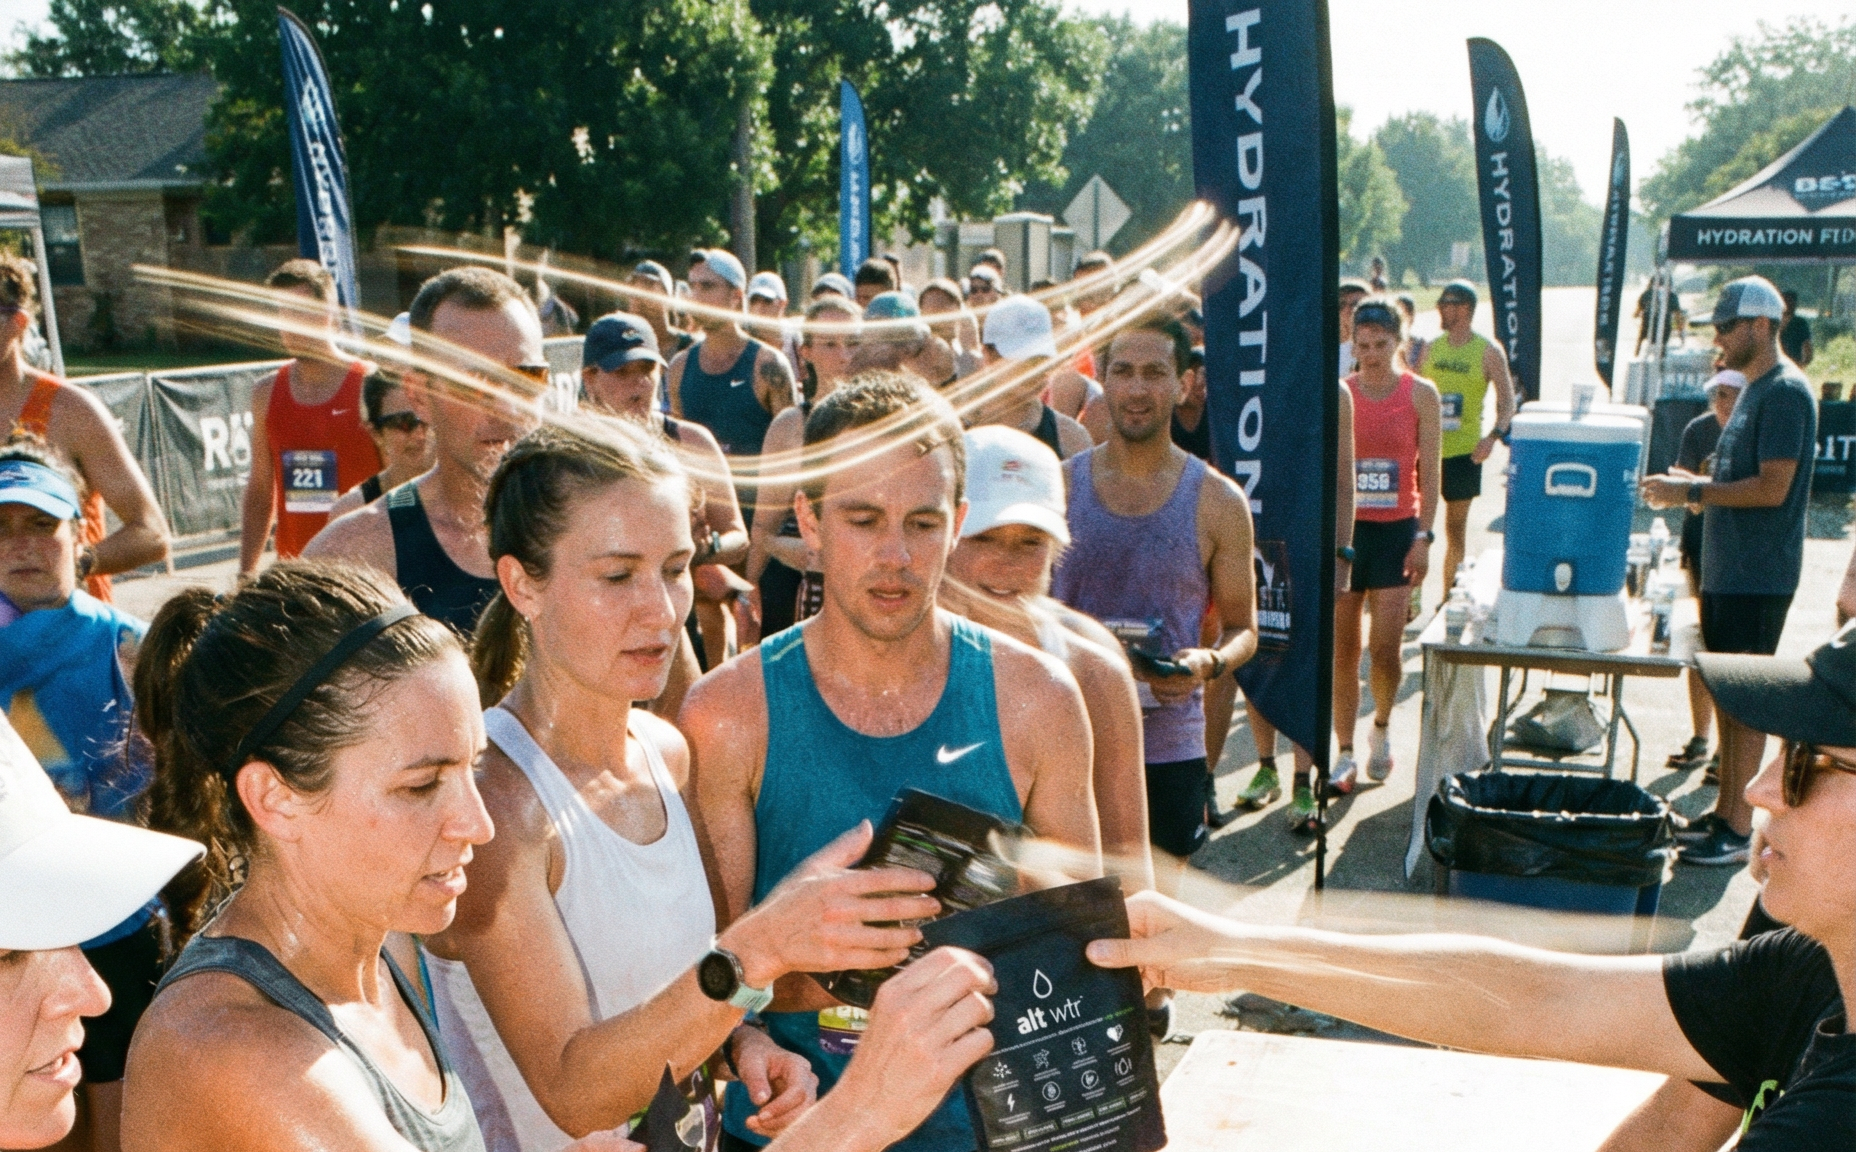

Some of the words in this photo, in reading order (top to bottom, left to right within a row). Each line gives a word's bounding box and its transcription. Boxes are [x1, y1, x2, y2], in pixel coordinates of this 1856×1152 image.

[1697, 228, 1813, 245] HYDRATION
[1225, 8, 1267, 514] HYDRATION
[1489, 152, 1518, 362] HYDRATION
[292, 468, 324, 488] 221
[1017, 1007, 1048, 1035] alt
[1049, 998, 1081, 1024] wtr
